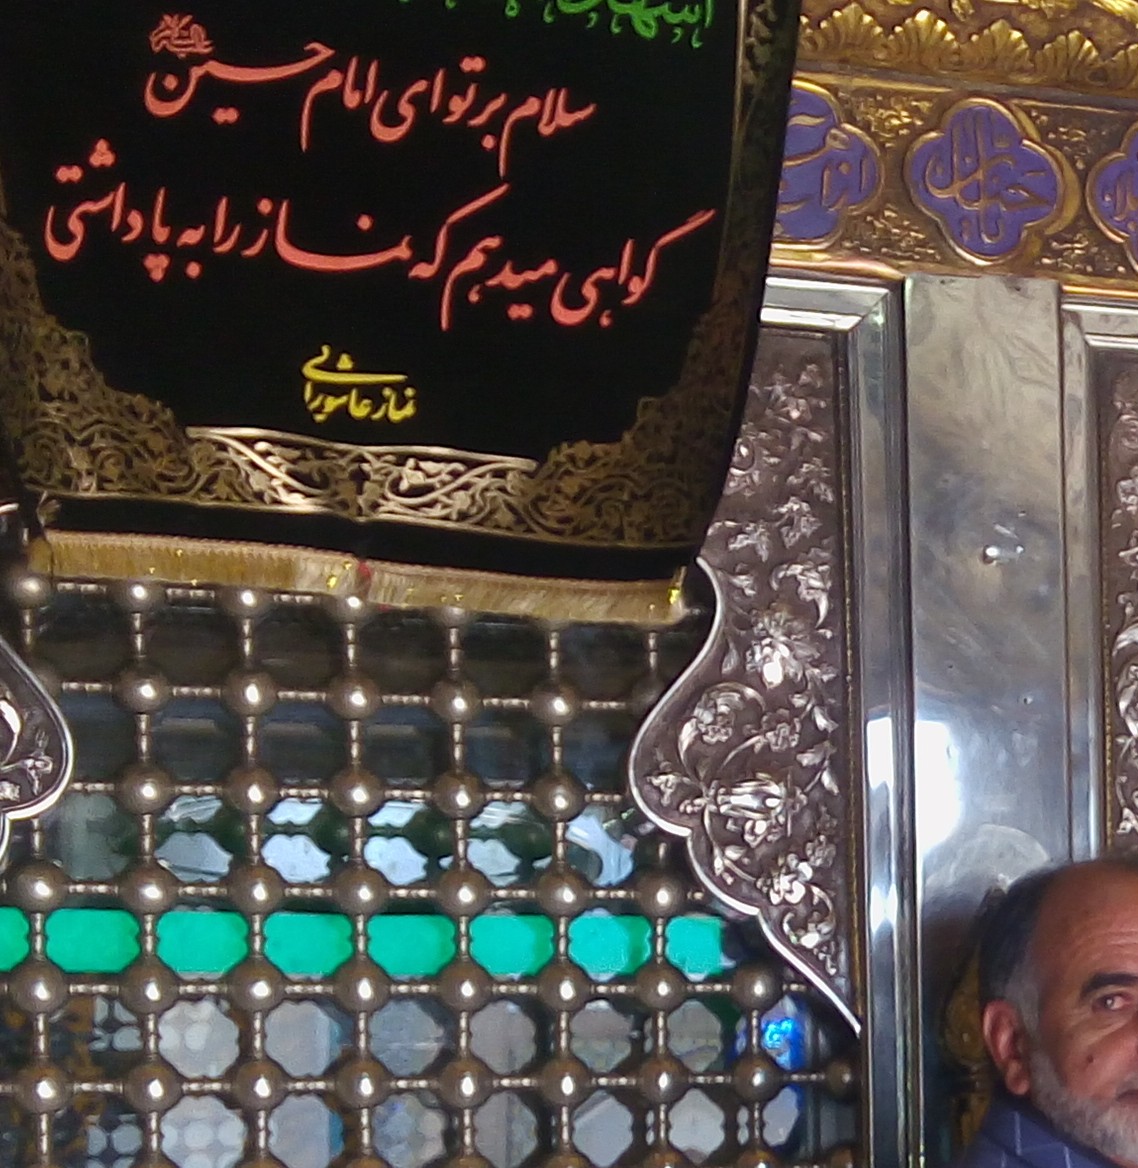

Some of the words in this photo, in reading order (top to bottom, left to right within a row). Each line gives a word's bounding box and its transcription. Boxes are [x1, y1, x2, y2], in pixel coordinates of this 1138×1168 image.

[143, 41, 336, 125] حسین
[302, 55, 379, 152] امام
[369, 67, 446, 143] ای
[443, 54, 488, 124] تو
[467, 92, 507, 150] بر
[500, 86, 597, 178] سلام
[175, 223, 207, 280] به
[212, 195, 242, 254] را
[240, 198, 414, 272] نماز
[408, 182, 511, 280] که
[551, 207, 717, 328] گواهی
[370, 386, 417, 424] نماز
